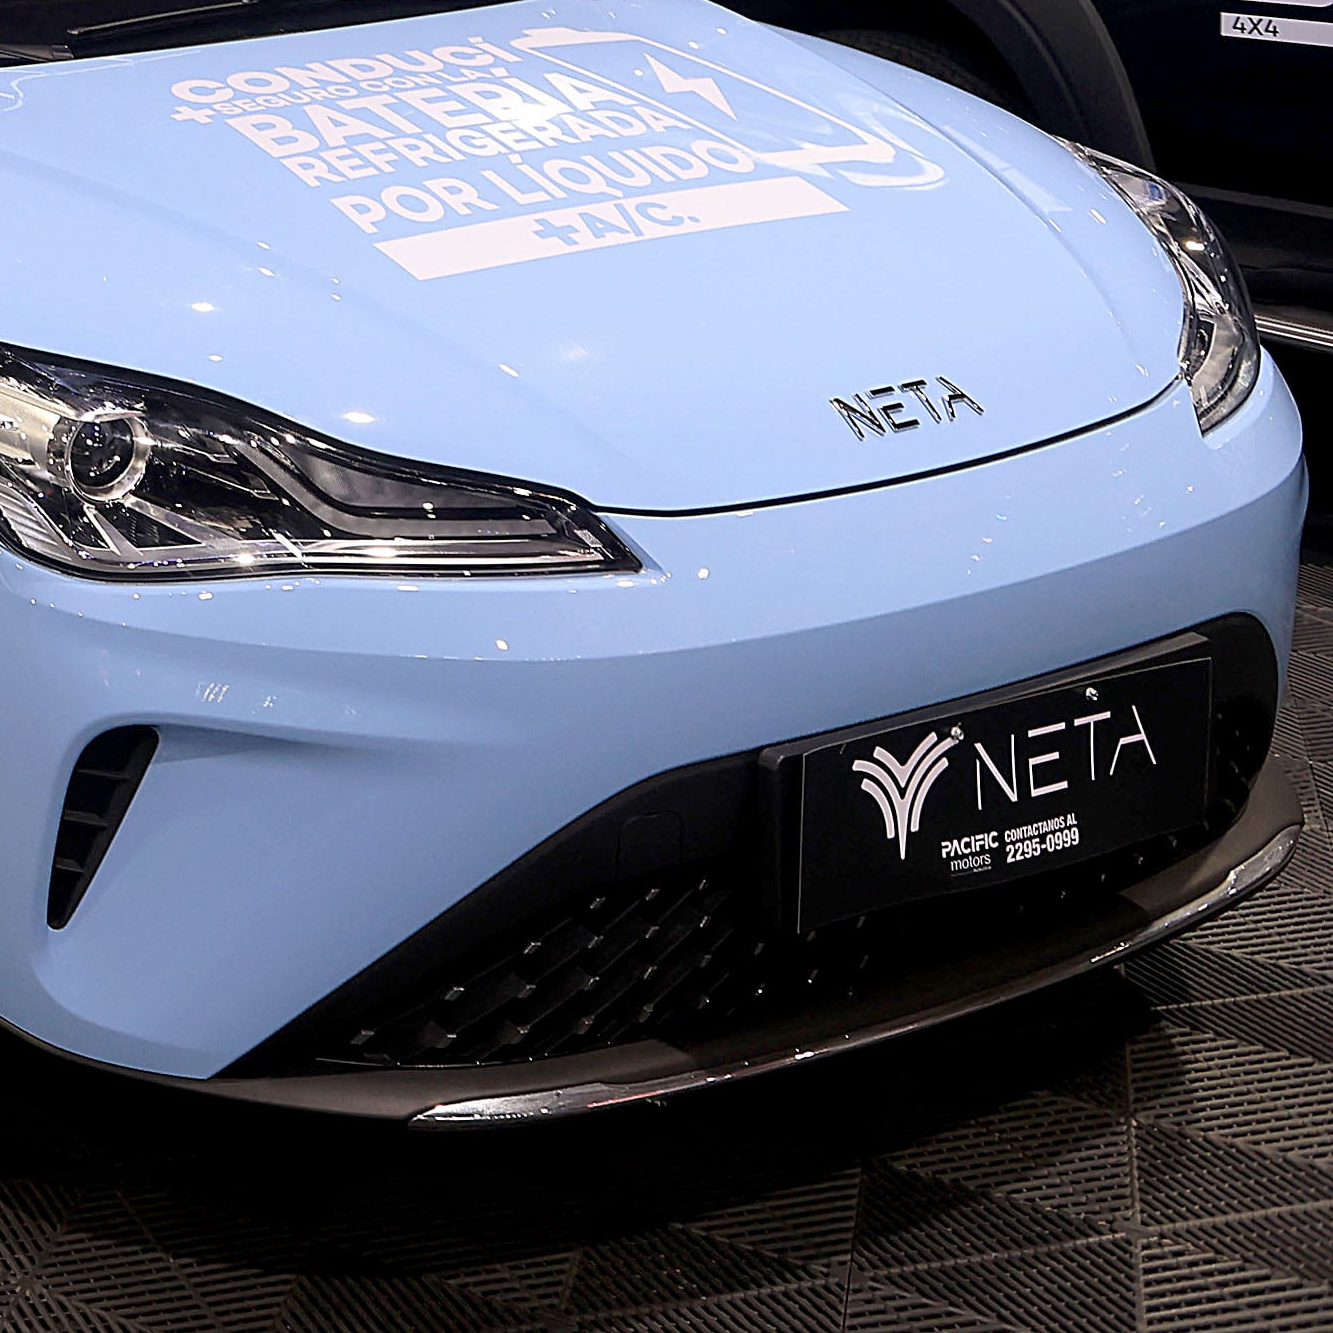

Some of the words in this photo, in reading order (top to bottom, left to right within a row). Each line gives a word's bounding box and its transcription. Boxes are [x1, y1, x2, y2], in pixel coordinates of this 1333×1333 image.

[170, 36, 523, 104] CONDUCÍ
[359, 70, 434, 93] CON
[436, 67, 483, 83] LA
[224, 66, 639, 159] BATERÍA
[279, 105, 693, 189] REFRIGERADA
[329, 177, 501, 236] POR
[481, 139, 757, 208] LÍQUIDO
[829, 375, 985, 441] NETA
[974, 705, 1157, 811] NETA
[940, 830, 999, 859] PACIFIC
[1004, 815, 1065, 843] CONTACTANOS
[1066, 812, 1078, 826] AL
[1005, 826, 1080, 864] 2295-0999
[950, 853, 992, 871] motors
